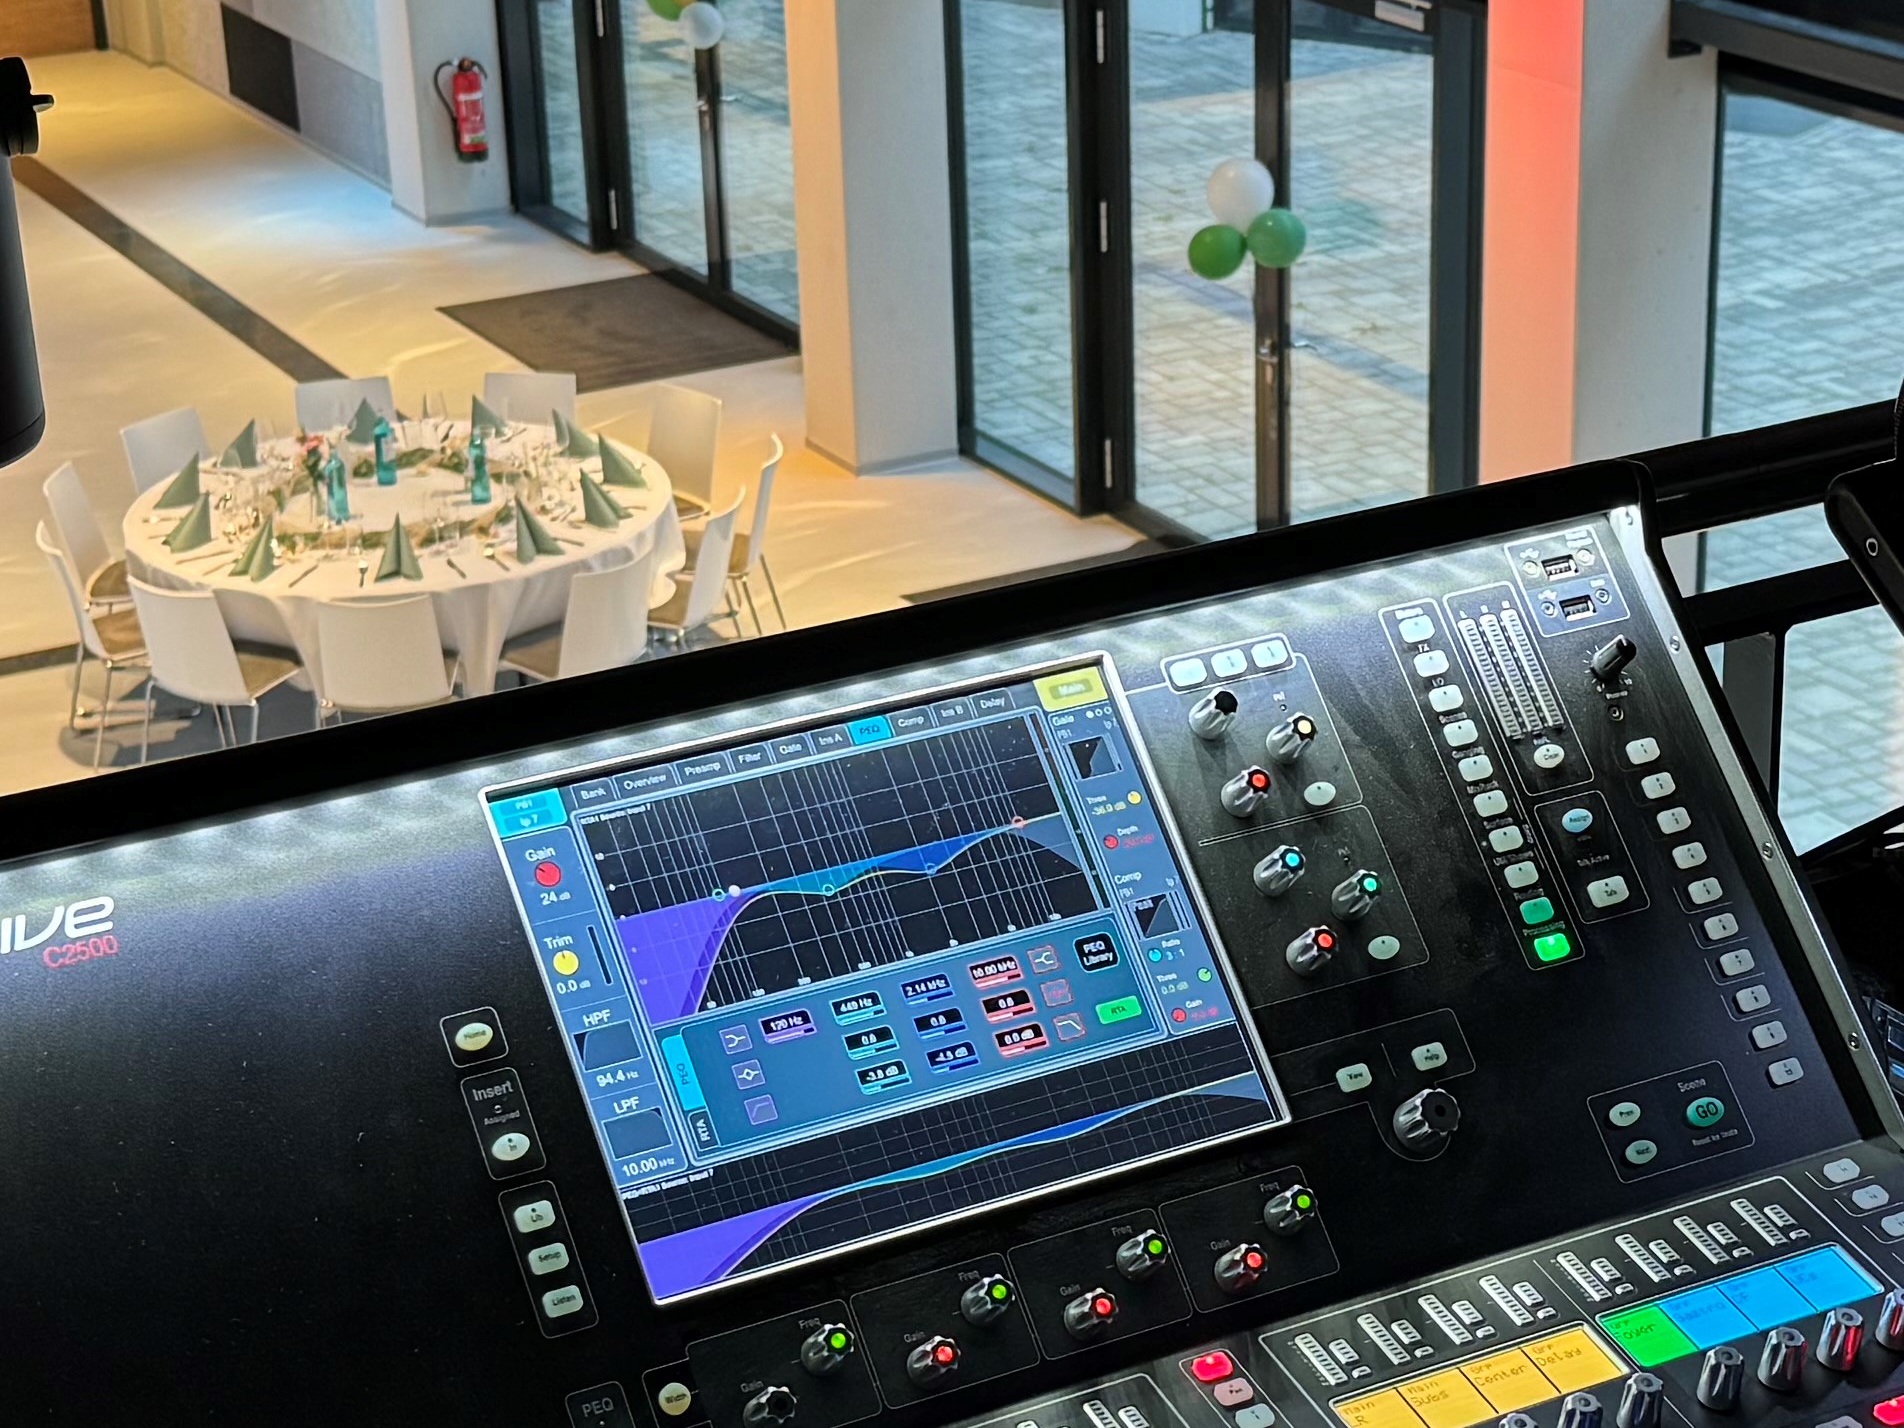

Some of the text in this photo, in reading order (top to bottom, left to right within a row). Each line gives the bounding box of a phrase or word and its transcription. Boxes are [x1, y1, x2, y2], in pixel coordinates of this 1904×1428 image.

[979, 695, 1006, 711] Delay
[897, 714, 925, 730] Comp
[684, 760, 721, 777] Preamp
[623, 773, 668, 791] Overview
[580, 787, 607, 801] Bank
[524, 845, 557, 863] Gain
[539, 889, 558, 907] 24
[543, 933, 573, 951] Trim
[43, 934, 120, 969] C2500
[556, 979, 578, 996] 0.0
[582, 1008, 612, 1027] HPF
[596, 1069, 627, 1088] 94.4
[472, 1081, 513, 1101] Insert
[612, 1096, 641, 1115] LPF
[1695, 1101, 1719, 1119] GO
[621, 1156, 659, 1178] 10.00
[1535, 1348, 1583, 1368] Delay
[1475, 1364, 1529, 1387] Center
[1410, 1390, 1450, 1408] Subs
